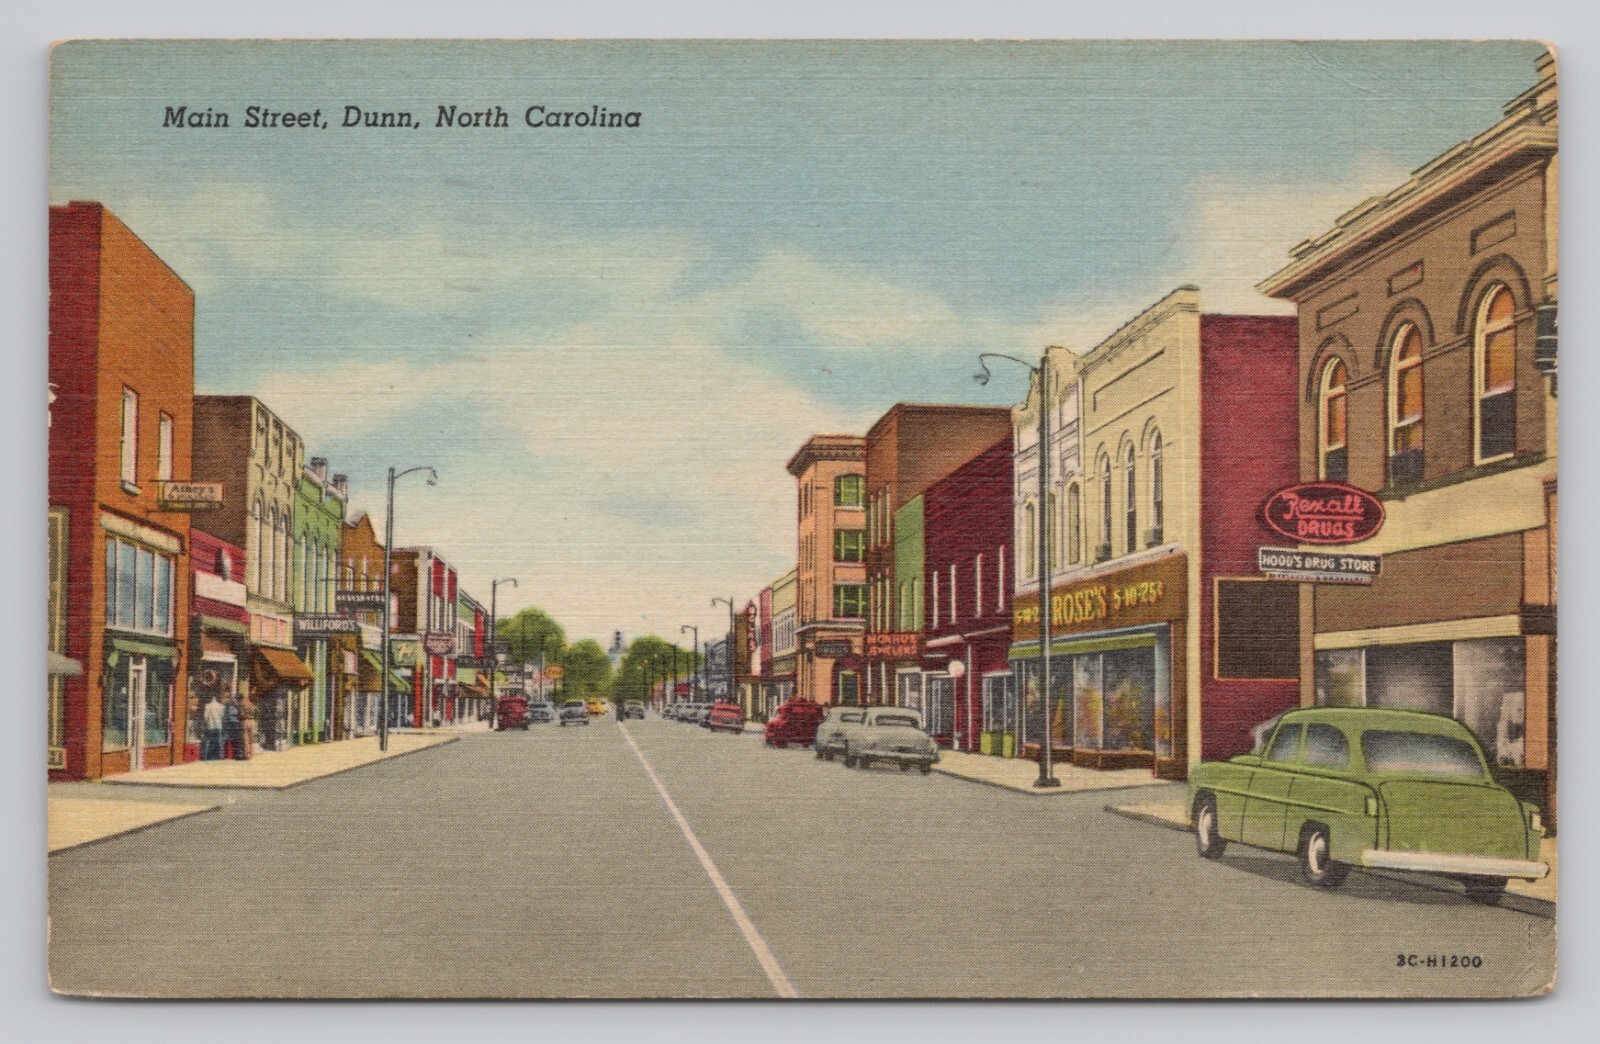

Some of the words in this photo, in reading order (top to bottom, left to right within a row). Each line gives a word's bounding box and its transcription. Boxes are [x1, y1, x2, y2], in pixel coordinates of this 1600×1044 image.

[1280, 492, 1365, 520] Rexall
[1297, 519, 1355, 539] DRUGS
[1262, 554, 1303, 569] HOOD'S
[1304, 556, 1335, 569] DRUG
[1340, 557, 1377, 572] STORE
[1052, 584, 1108, 626] ROSE'S
